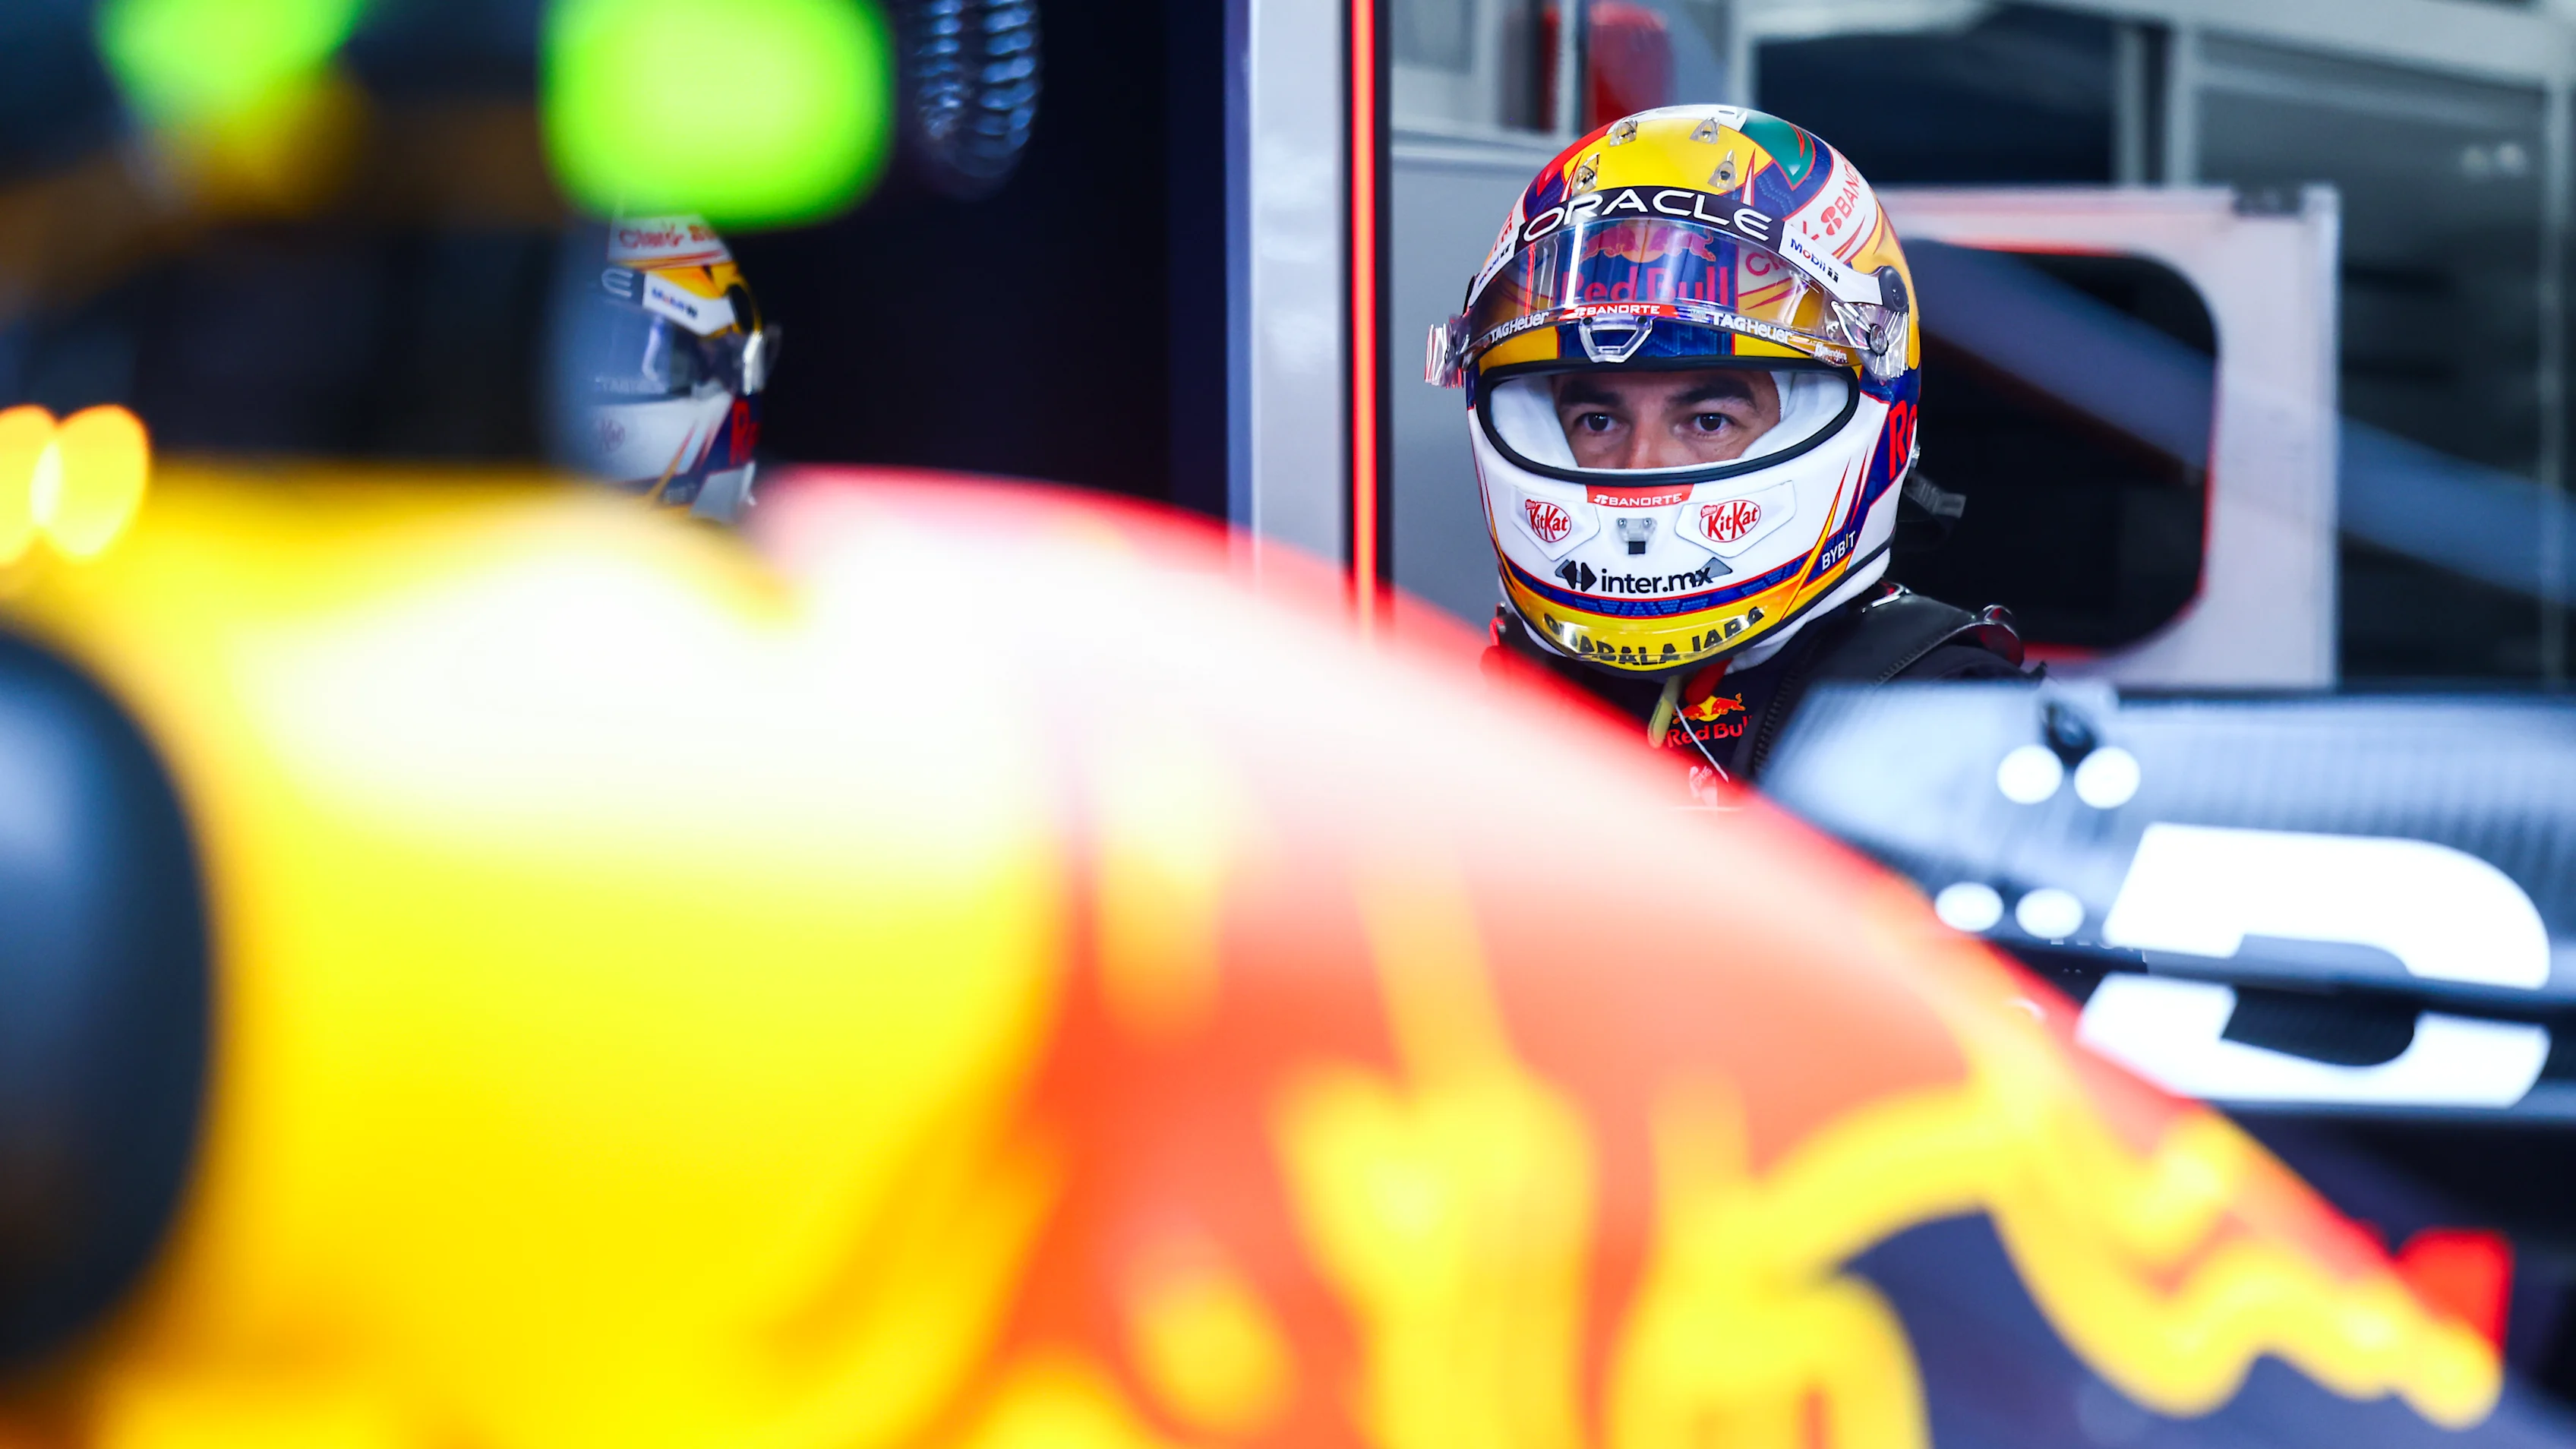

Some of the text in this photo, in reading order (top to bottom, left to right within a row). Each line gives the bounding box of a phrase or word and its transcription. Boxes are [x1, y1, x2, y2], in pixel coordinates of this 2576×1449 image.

[1523, 188, 1773, 242] ORACLE
[1646, 267, 1729, 305] Bull
[1586, 305, 1661, 316] BANORTE
[1608, 493, 1682, 507] BANORTE
[1530, 504, 1569, 541] KitKat
[1707, 502, 1758, 541] KitKat
[1822, 530, 1856, 571] BYBIT
[1601, 566, 1714, 595] inter.mx
[1666, 724, 1710, 748] Red
